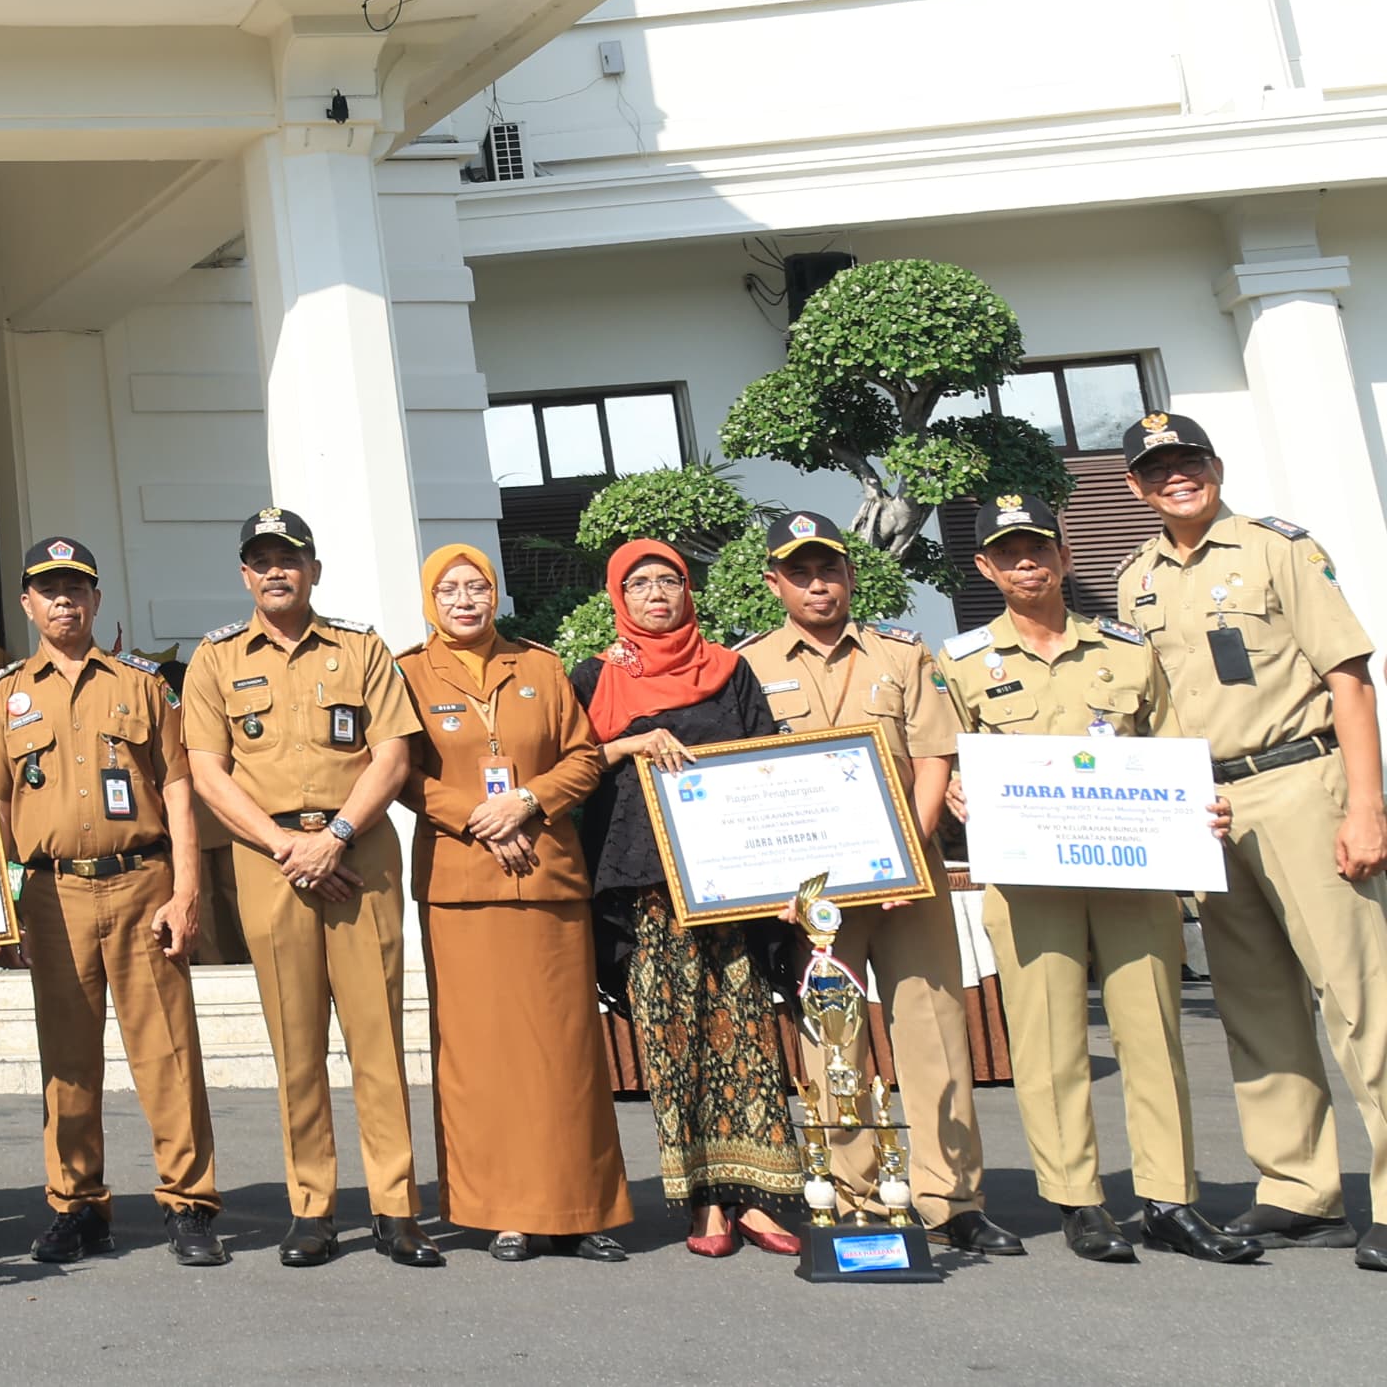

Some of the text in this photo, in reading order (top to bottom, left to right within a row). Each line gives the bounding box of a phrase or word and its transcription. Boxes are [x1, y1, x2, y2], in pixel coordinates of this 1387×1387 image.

[1001, 784, 1187, 802] JUARA HARAPAN 2
[744, 837, 773, 850] JUARA
[776, 831, 819, 846] HARAPAN
[1056, 843, 1148, 868] 1.500.000
